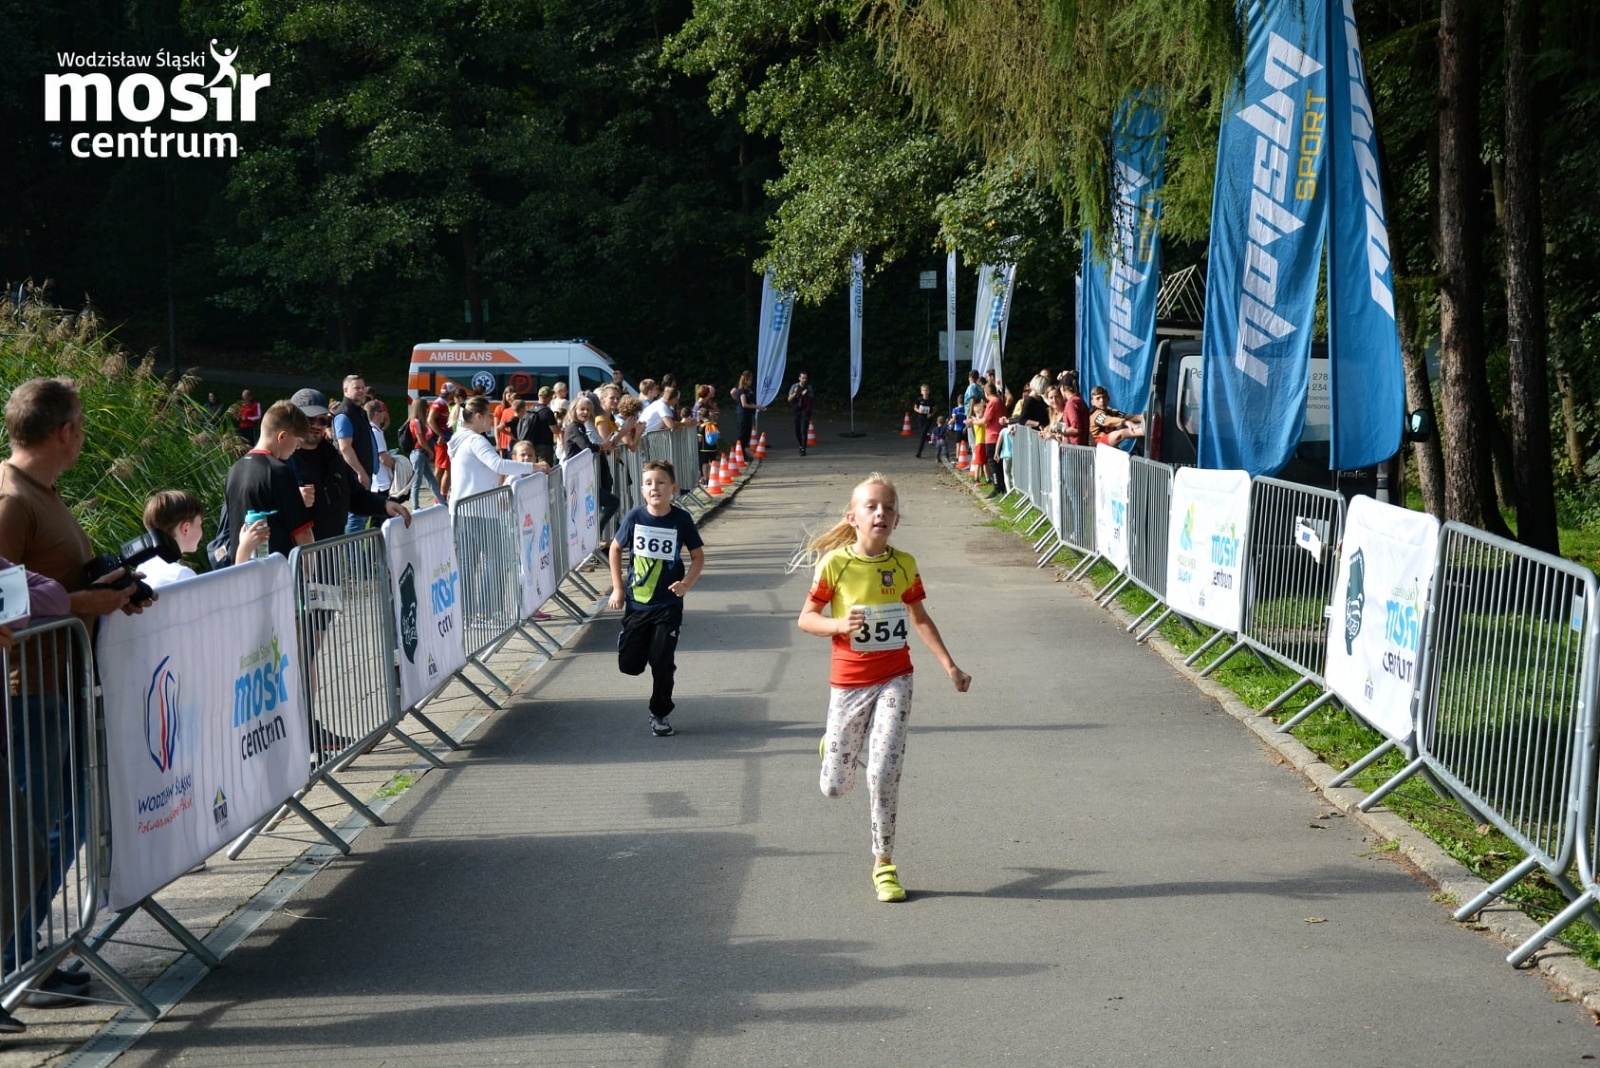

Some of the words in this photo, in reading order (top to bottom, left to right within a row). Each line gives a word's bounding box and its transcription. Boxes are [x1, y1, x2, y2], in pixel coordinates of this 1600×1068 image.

[1295, 89, 1326, 201] SPORT
[429, 351, 493, 361] AMBULANS
[635, 535, 674, 555] 368
[854, 618, 908, 644] 354
